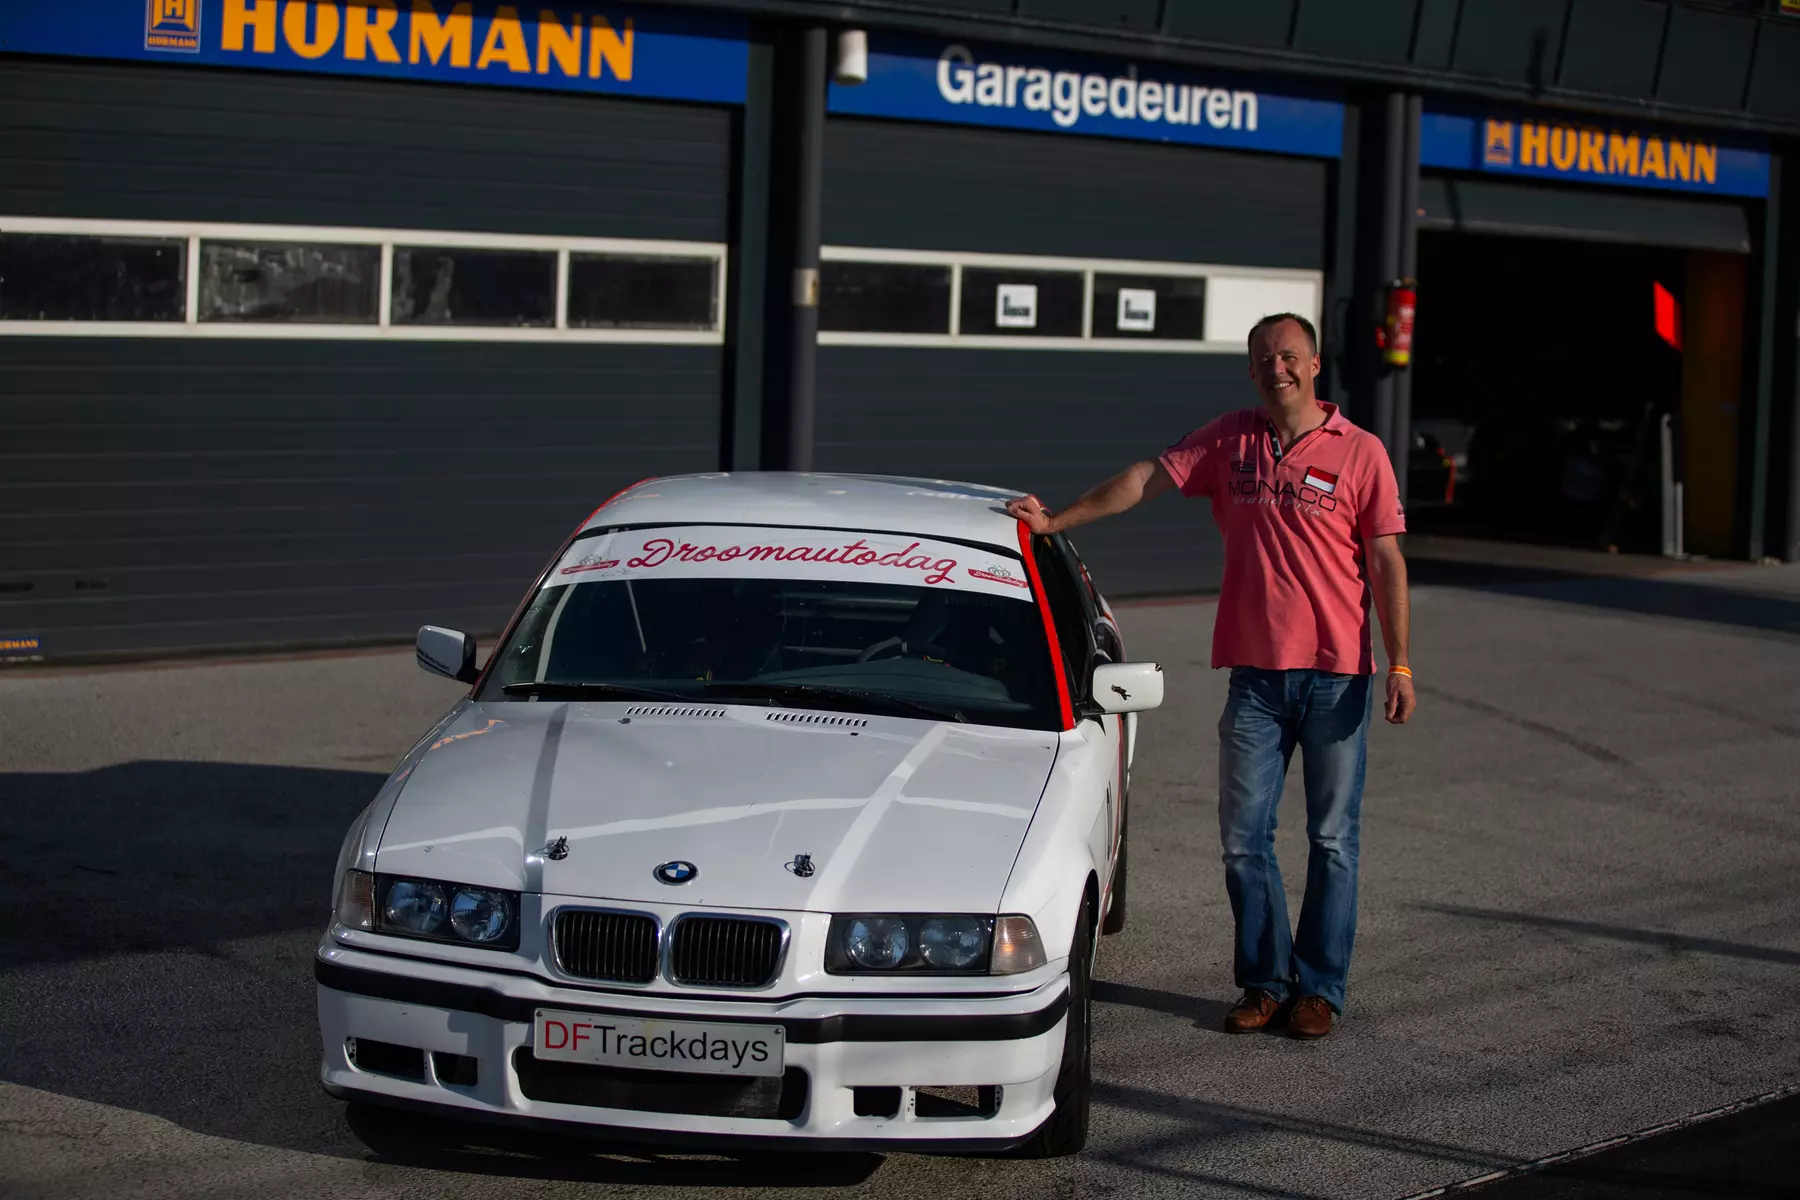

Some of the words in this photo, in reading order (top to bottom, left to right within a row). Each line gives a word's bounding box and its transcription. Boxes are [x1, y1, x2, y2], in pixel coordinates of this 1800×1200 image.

[936, 44, 1258, 131] Garagedeuren
[1229, 479, 1336, 512] MONACO
[627, 537, 958, 585] Droomautodag
[544, 1020, 769, 1069] DFTrackdays
